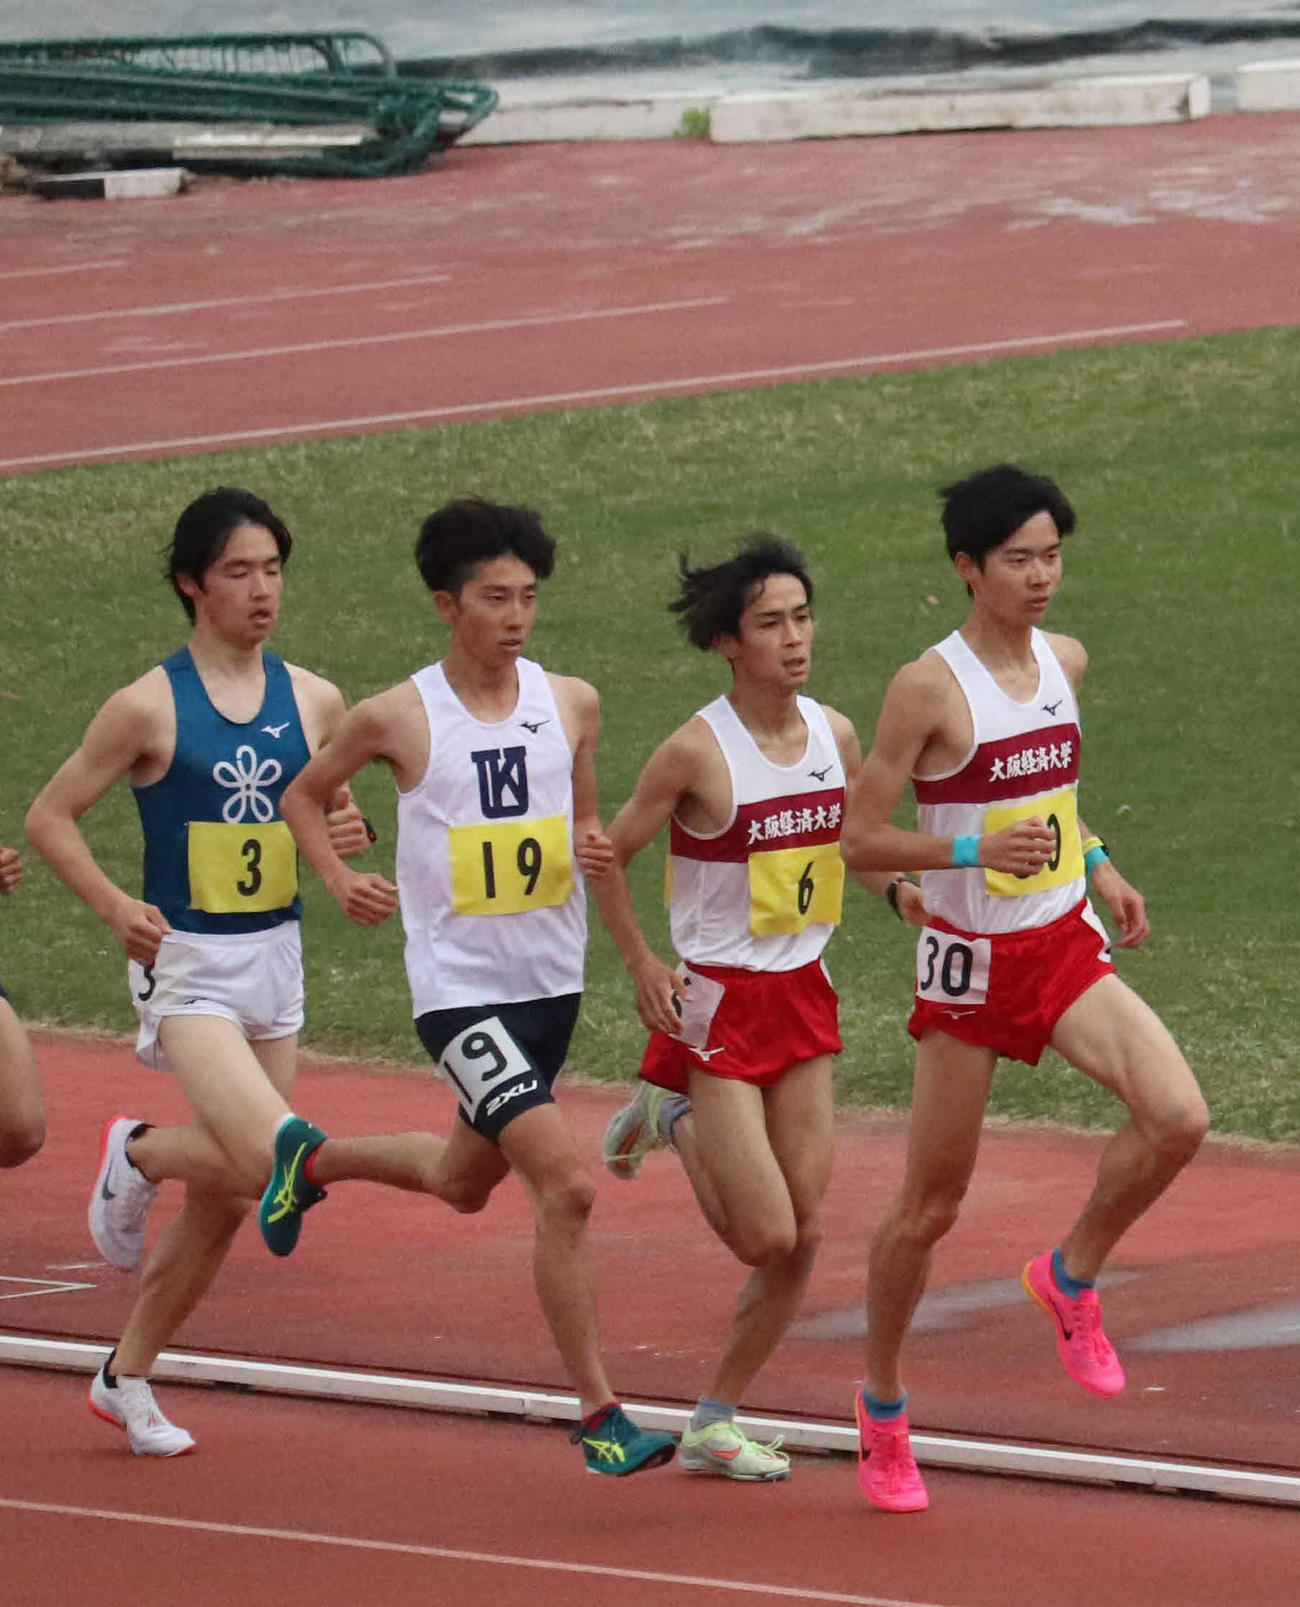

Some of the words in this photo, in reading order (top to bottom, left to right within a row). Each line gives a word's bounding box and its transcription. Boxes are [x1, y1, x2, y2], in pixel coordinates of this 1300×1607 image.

[989, 740, 1073, 782] 大阪経済大学
[746, 802, 843, 846] 大阪経済大学
[236, 838, 262, 897] 3
[482, 837, 542, 899] 19
[797, 861, 815, 916] 6
[920, 935, 974, 998] 30
[443, 1031, 508, 1106] 19
[485, 1079, 538, 1117] 2XU
